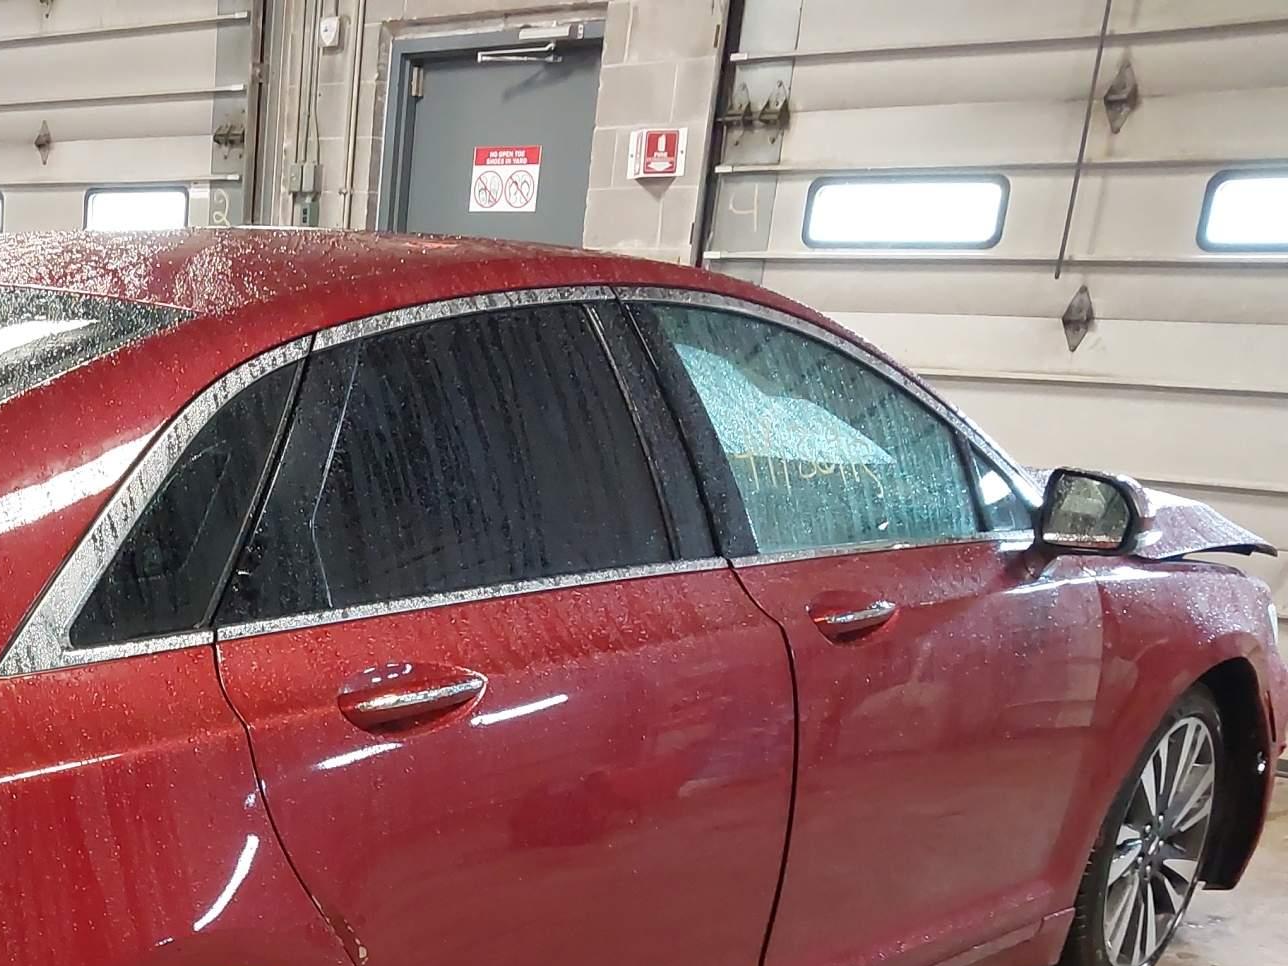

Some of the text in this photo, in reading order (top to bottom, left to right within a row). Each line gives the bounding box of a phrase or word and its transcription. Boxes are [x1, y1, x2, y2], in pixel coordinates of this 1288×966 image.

[489, 150, 498, 158] NO
[498, 150, 514, 158] OPEN
[212, 188, 231, 227] 2
